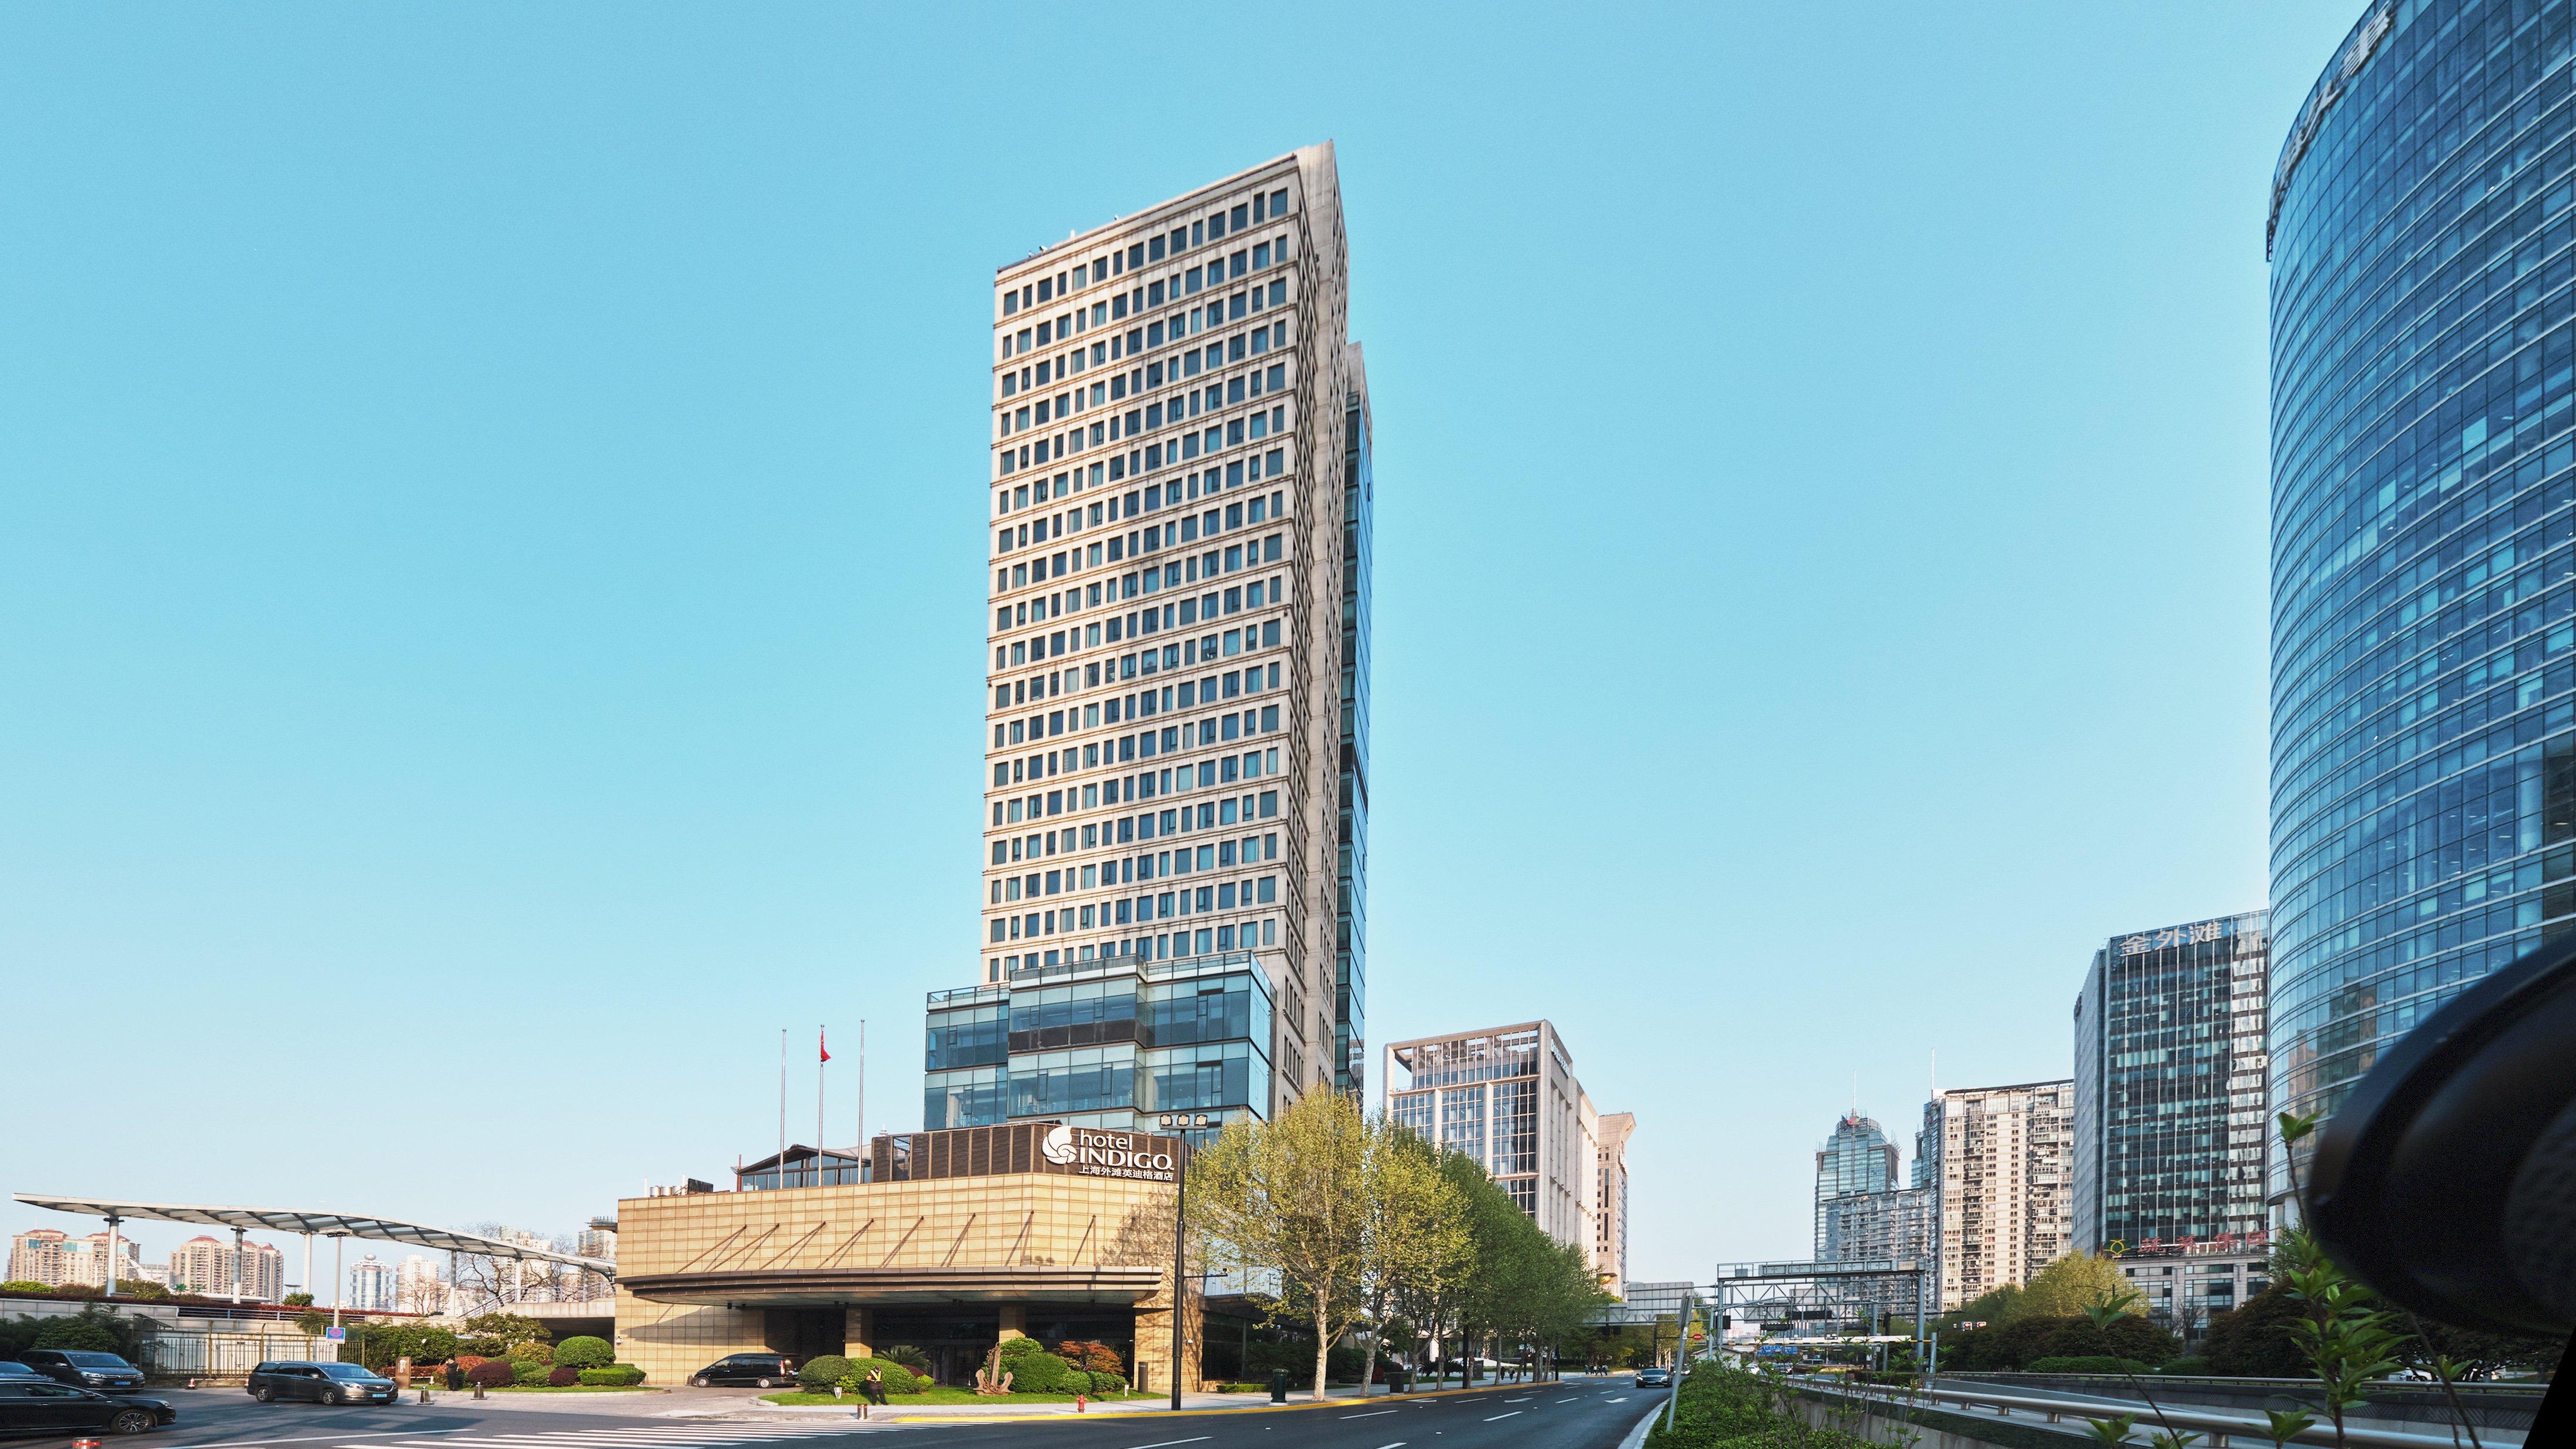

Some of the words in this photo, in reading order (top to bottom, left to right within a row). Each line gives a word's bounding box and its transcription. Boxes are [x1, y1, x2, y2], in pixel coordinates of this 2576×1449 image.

[2119, 922, 2222, 957] 金外滩
[1080, 1129, 1133, 1150] hotel
[1080, 1147, 1174, 1170] INDIGO
[1079, 1164, 1174, 1181] 上海外滩英迪格酒店
[2137, 1230, 2269, 1253] 蔬菜集团
